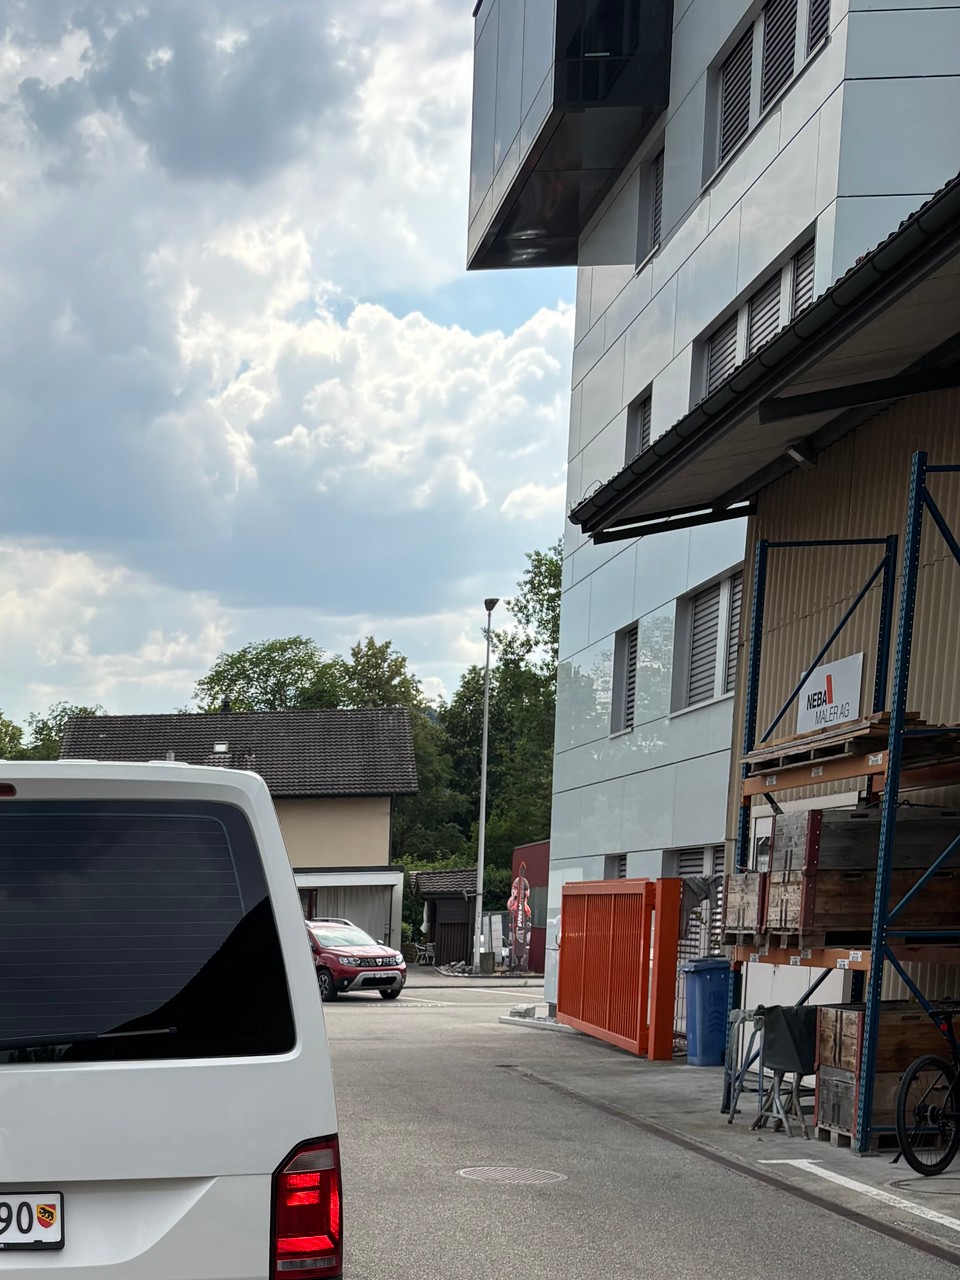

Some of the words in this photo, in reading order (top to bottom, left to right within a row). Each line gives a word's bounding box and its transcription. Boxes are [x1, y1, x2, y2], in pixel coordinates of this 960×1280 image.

[806, 690, 827, 711] NEBA
[815, 705, 839, 725] MALER
[839, 702, 850, 719] AG
